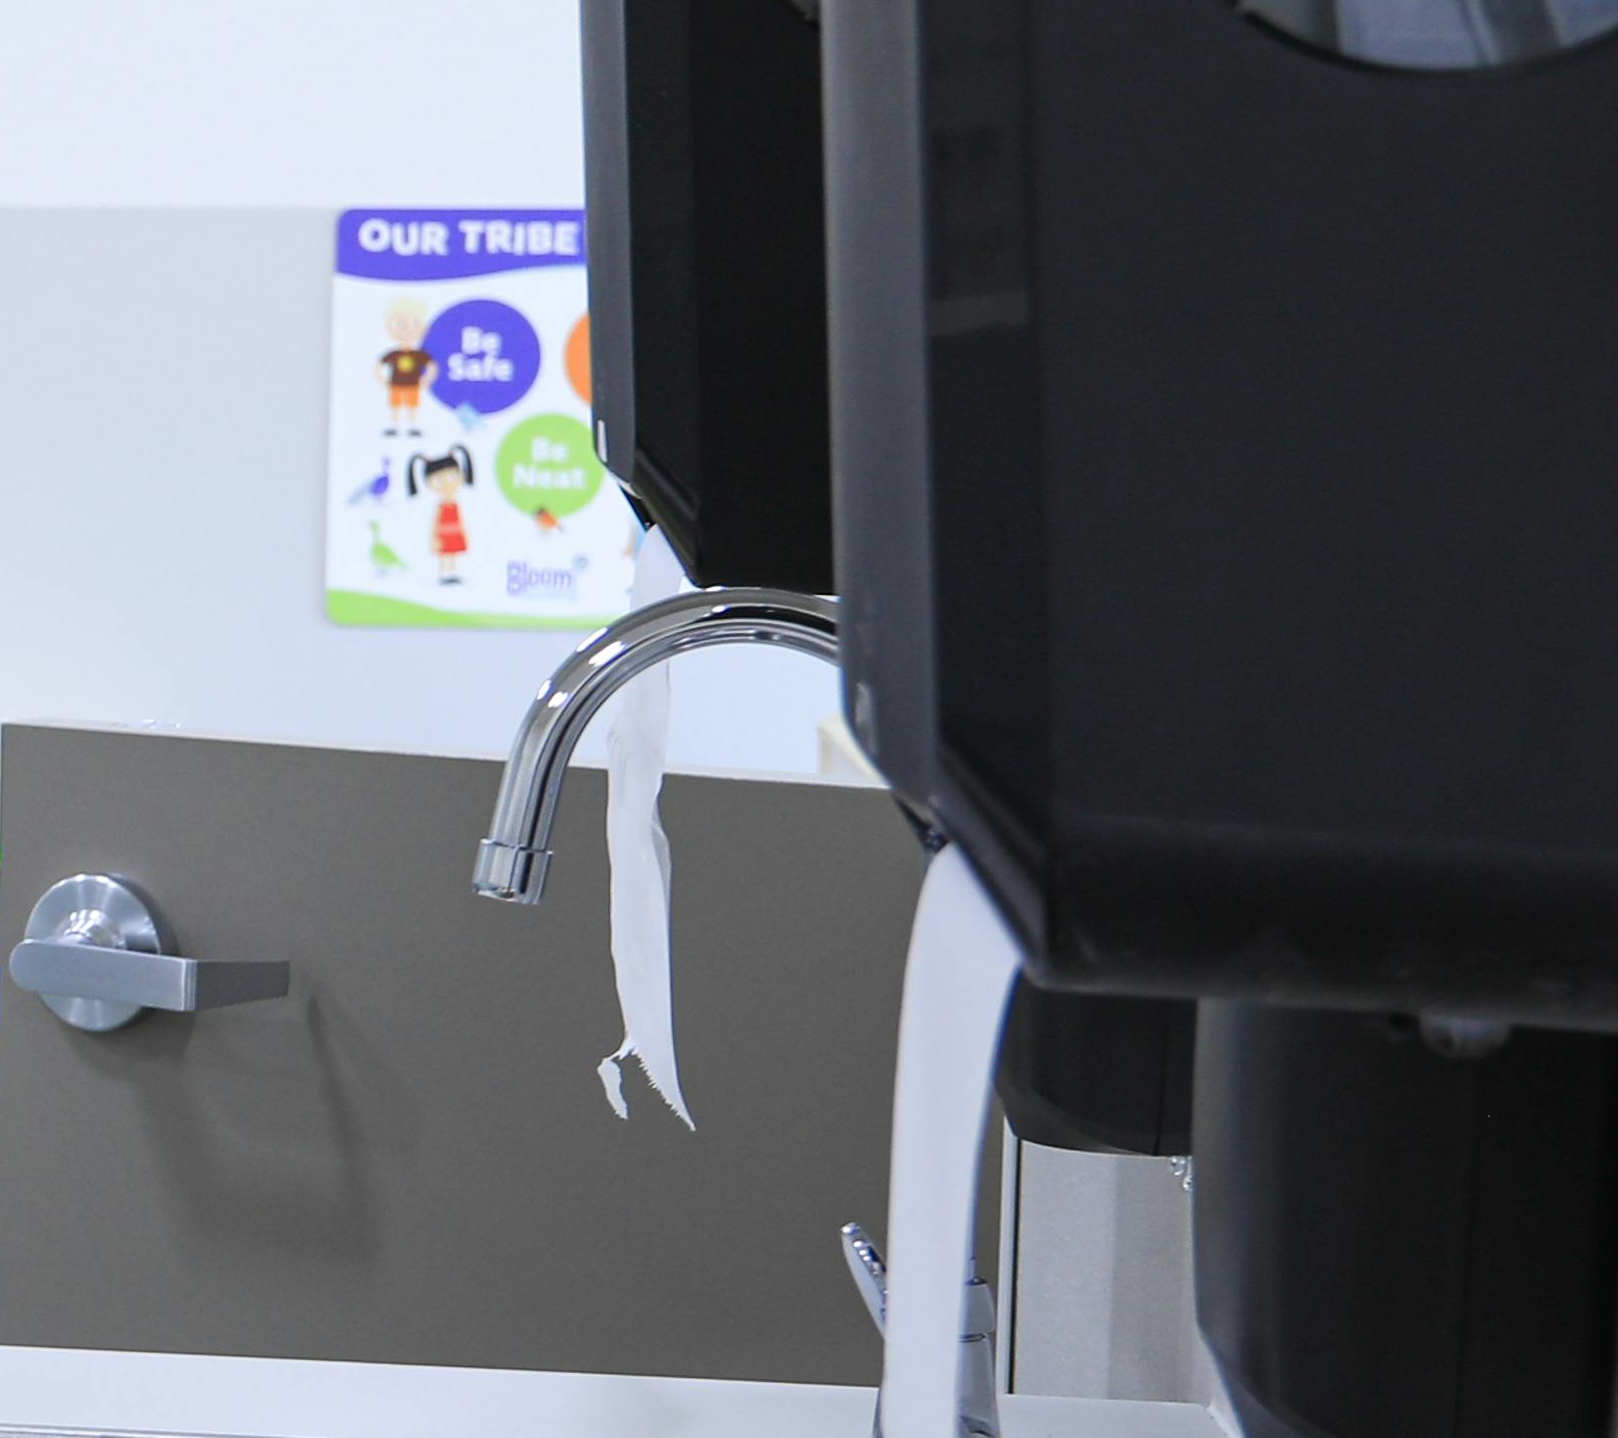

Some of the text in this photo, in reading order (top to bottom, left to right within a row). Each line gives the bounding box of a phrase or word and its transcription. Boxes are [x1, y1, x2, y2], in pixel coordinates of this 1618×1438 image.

[358, 218, 580, 256] OUR TRIBE
[461, 326, 502, 355] Be
[448, 353, 514, 381] Safe
[531, 437, 569, 463] Be
[513, 465, 586, 490] Neat
[507, 561, 573, 596] Bloom
